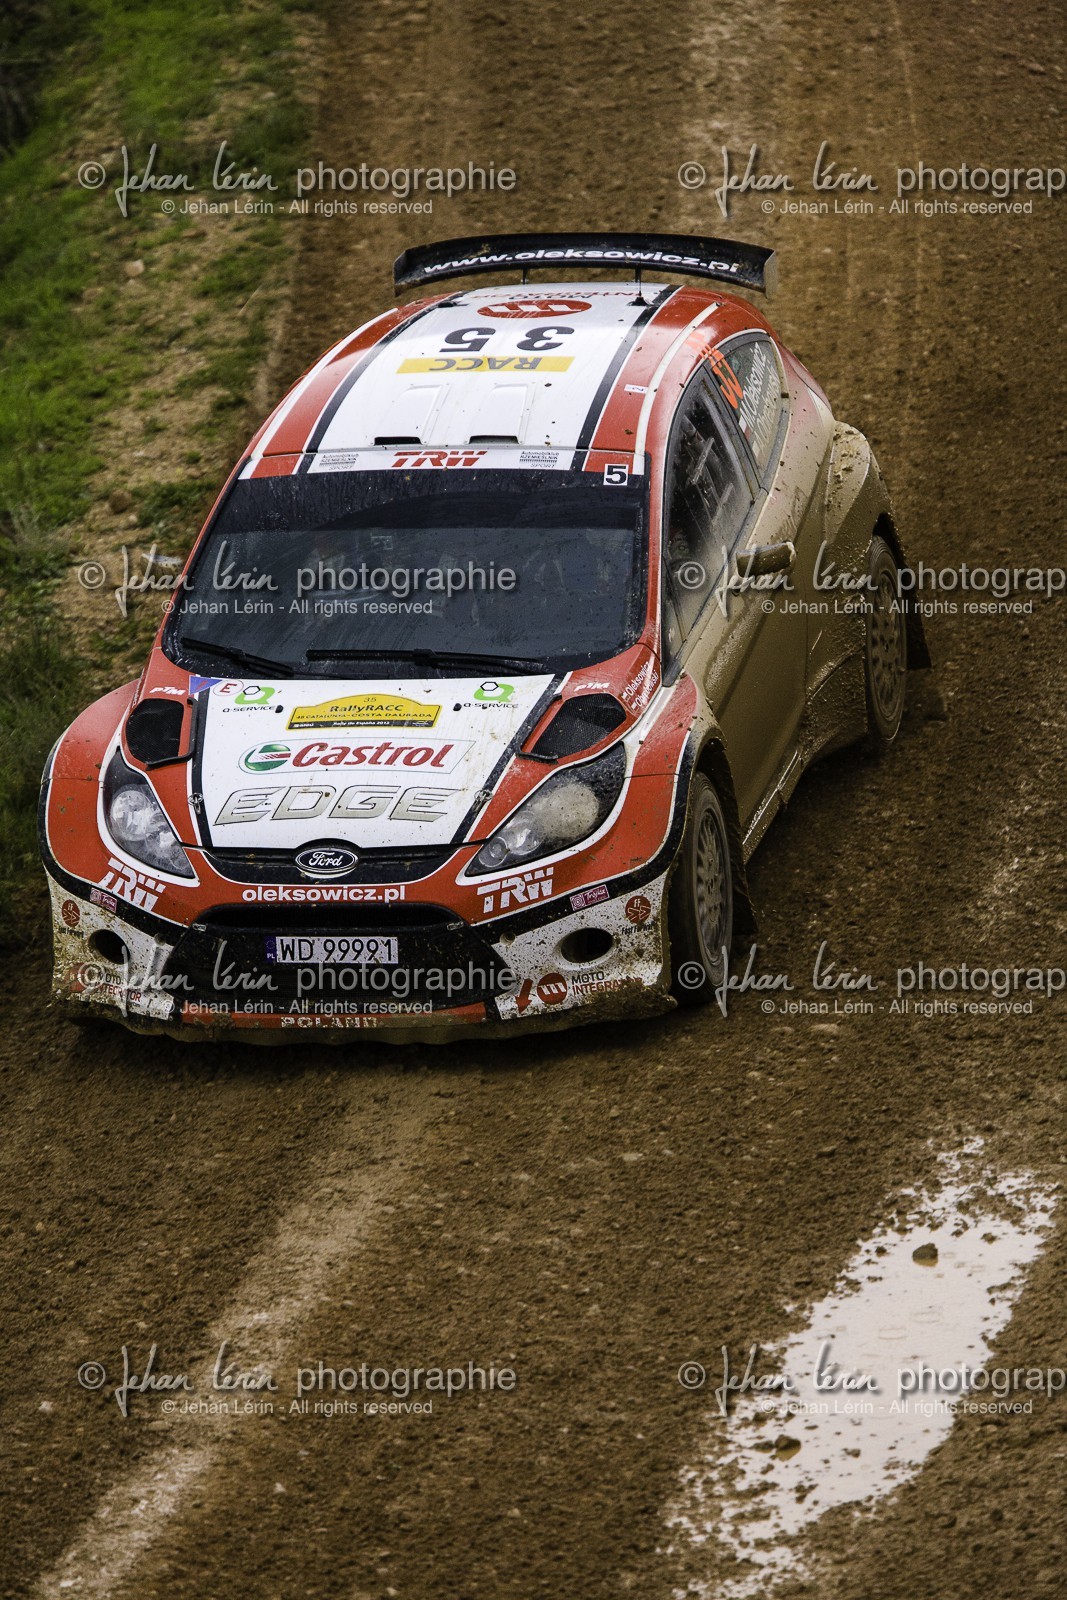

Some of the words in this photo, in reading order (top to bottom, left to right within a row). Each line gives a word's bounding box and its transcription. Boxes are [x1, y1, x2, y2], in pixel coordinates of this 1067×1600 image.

[424, 248, 739, 274] www.oleksowicz.pl
[429, 356, 543, 371] RACC
[392, 450, 488, 468] TRW
[605, 465, 627, 485] 5
[219, 683, 237, 693] E
[292, 741, 455, 768] Castrol
[213, 784, 462, 826] EDGE
[308, 852, 344, 866] Ford
[98, 857, 166, 912] TRW
[242, 885, 405, 903] oleksowicz.pl
[476, 866, 554, 913] TRW
[279, 939, 314, 961] WD
[323, 939, 392, 961] 99991
[571, 971, 604, 985] MOTO
